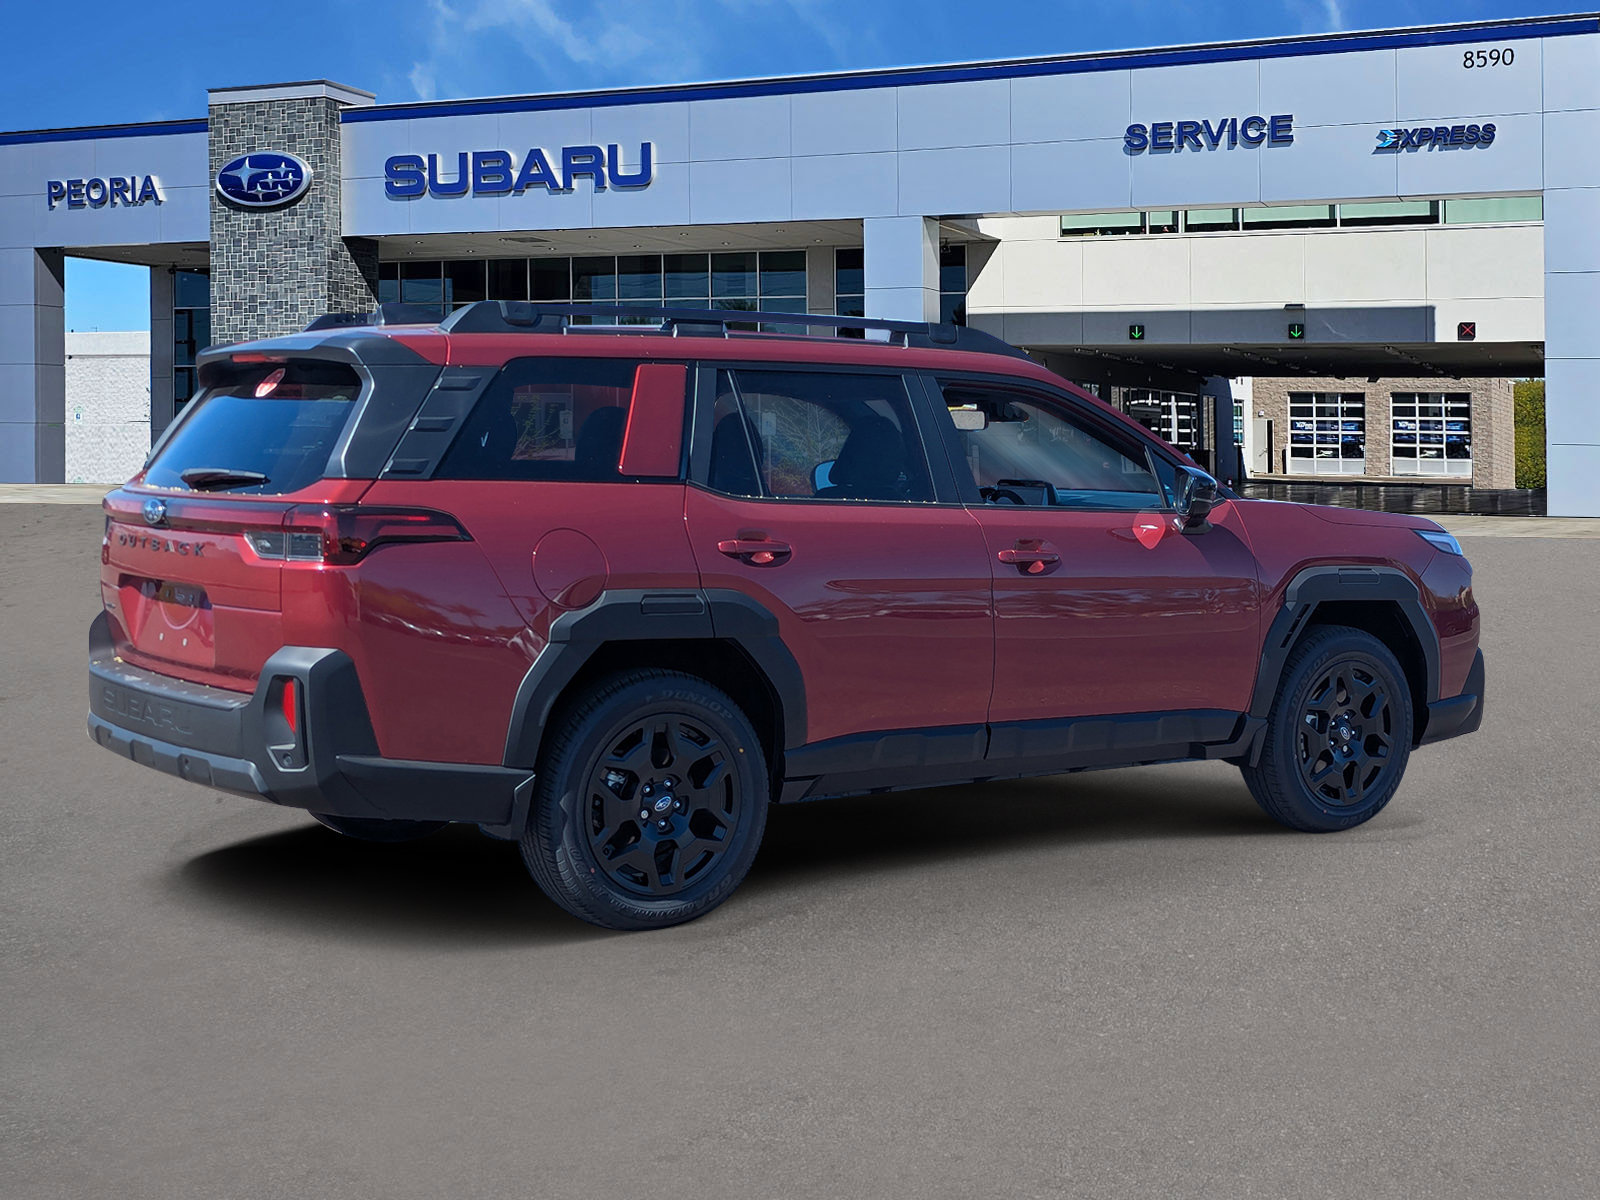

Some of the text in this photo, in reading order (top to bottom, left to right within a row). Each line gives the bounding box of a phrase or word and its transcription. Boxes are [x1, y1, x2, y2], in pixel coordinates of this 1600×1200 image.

[1463, 48, 1515, 69] 8590
[1125, 114, 1294, 153] SERVICE
[1375, 123, 1496, 149] EXPRESS
[384, 141, 652, 198] SUBARU
[48, 174, 162, 209] PEORIA
[119, 533, 206, 557] OUTBACK
